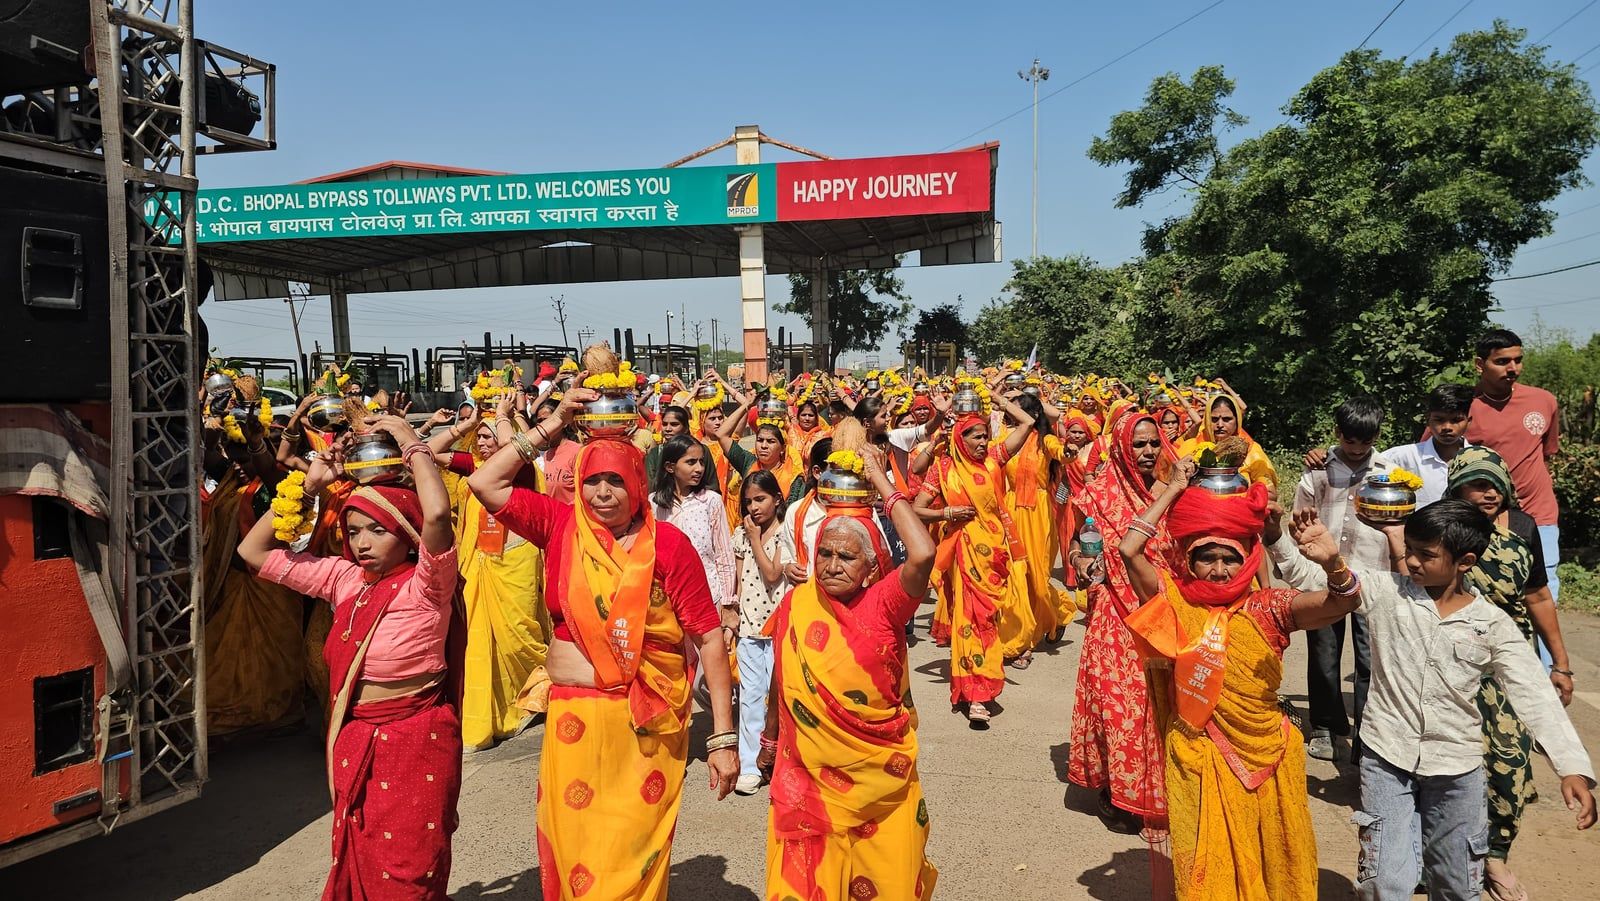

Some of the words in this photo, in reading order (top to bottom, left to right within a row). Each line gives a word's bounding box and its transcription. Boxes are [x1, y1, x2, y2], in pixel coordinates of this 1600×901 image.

[243, 192, 305, 212] BHOPAL
[308, 189, 369, 209] BYPASS
[372, 185, 456, 206] TOLLWAYS
[460, 184, 492, 202] PVT.
[497, 182, 532, 200] LTD.
[535, 178, 632, 199] WELCOMES
[635, 176, 671, 195] YOU
[793, 178, 858, 203] HAPPY
[862, 171, 958, 200] JOURNEY
[209, 217, 262, 236] भोपाल
[267, 217, 334, 234] बायपास
[412, 213, 436, 229] प्रा.
[438, 207, 467, 228] लि.
[469, 209, 531, 226] आपका
[536, 206, 598, 224] स्वागत
[605, 205, 658, 222] करता
[663, 199, 679, 222] है
[728, 206, 758, 216] MPRDC
